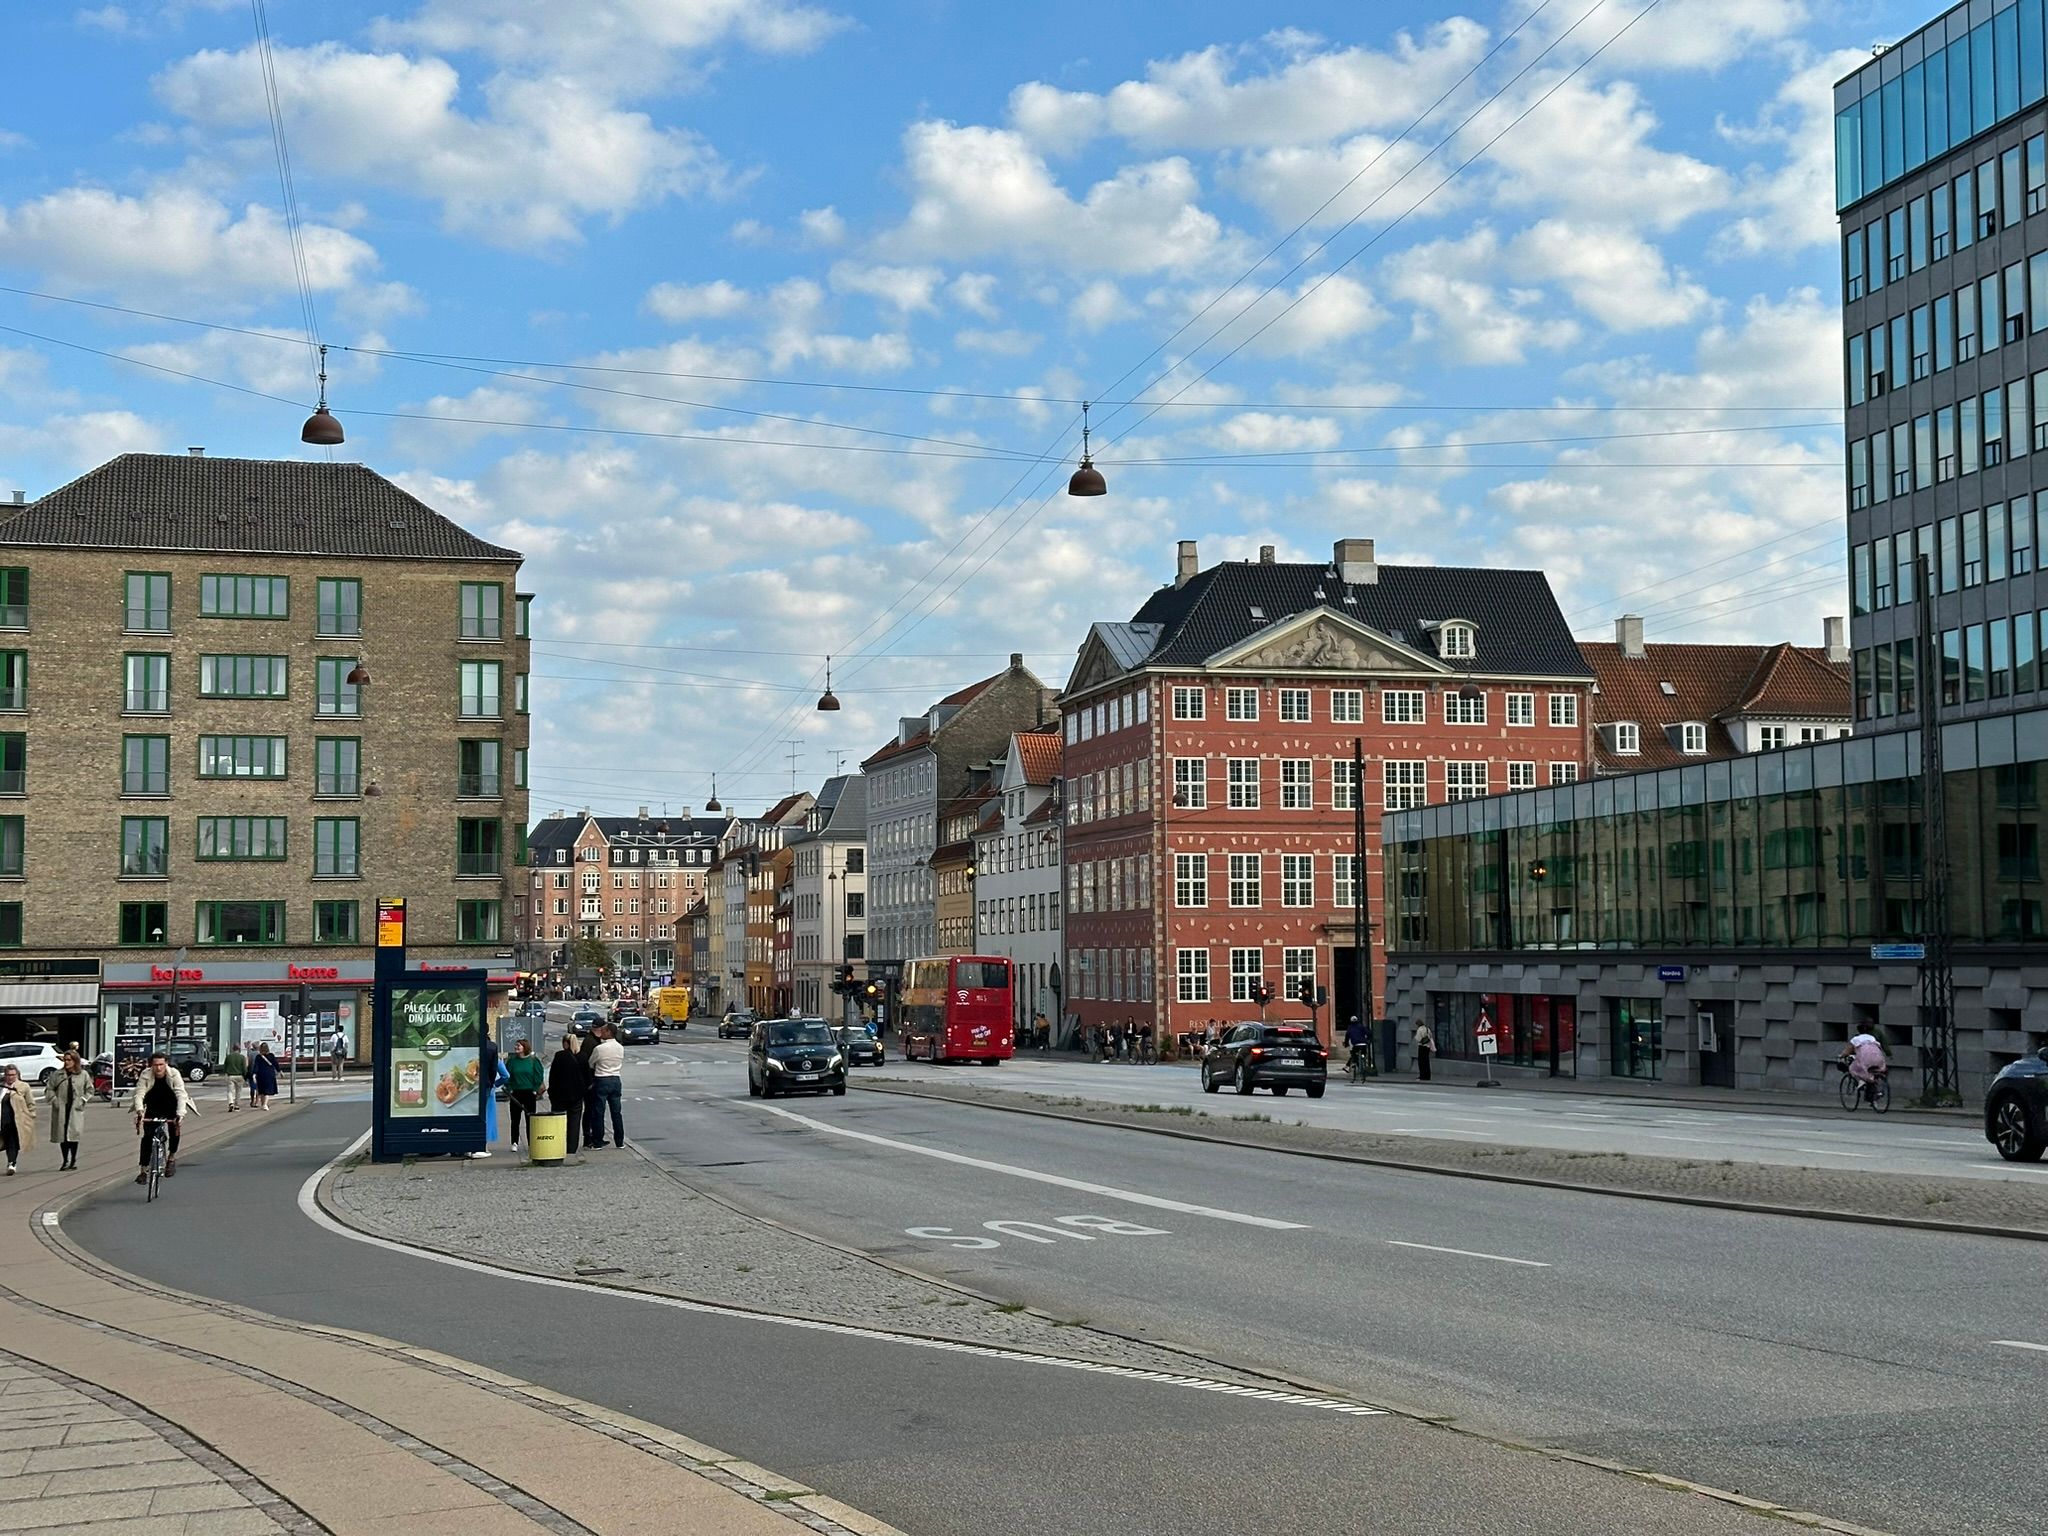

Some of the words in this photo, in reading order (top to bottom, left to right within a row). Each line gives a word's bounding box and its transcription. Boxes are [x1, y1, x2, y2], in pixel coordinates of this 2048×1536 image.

[151, 964, 203, 981] home
[288, 962, 339, 980] home
[403, 1001, 431, 1013] PÅLÆG
[433, 1003, 452, 1013] LIGE
[454, 1003, 468, 1013] TIL
[408, 1013, 423, 1023] DIN
[425, 1012, 463, 1023] HVERDAG
[1188, 1020, 1241, 1028] RESTUANT
[905, 1215, 1173, 1249] BUS
